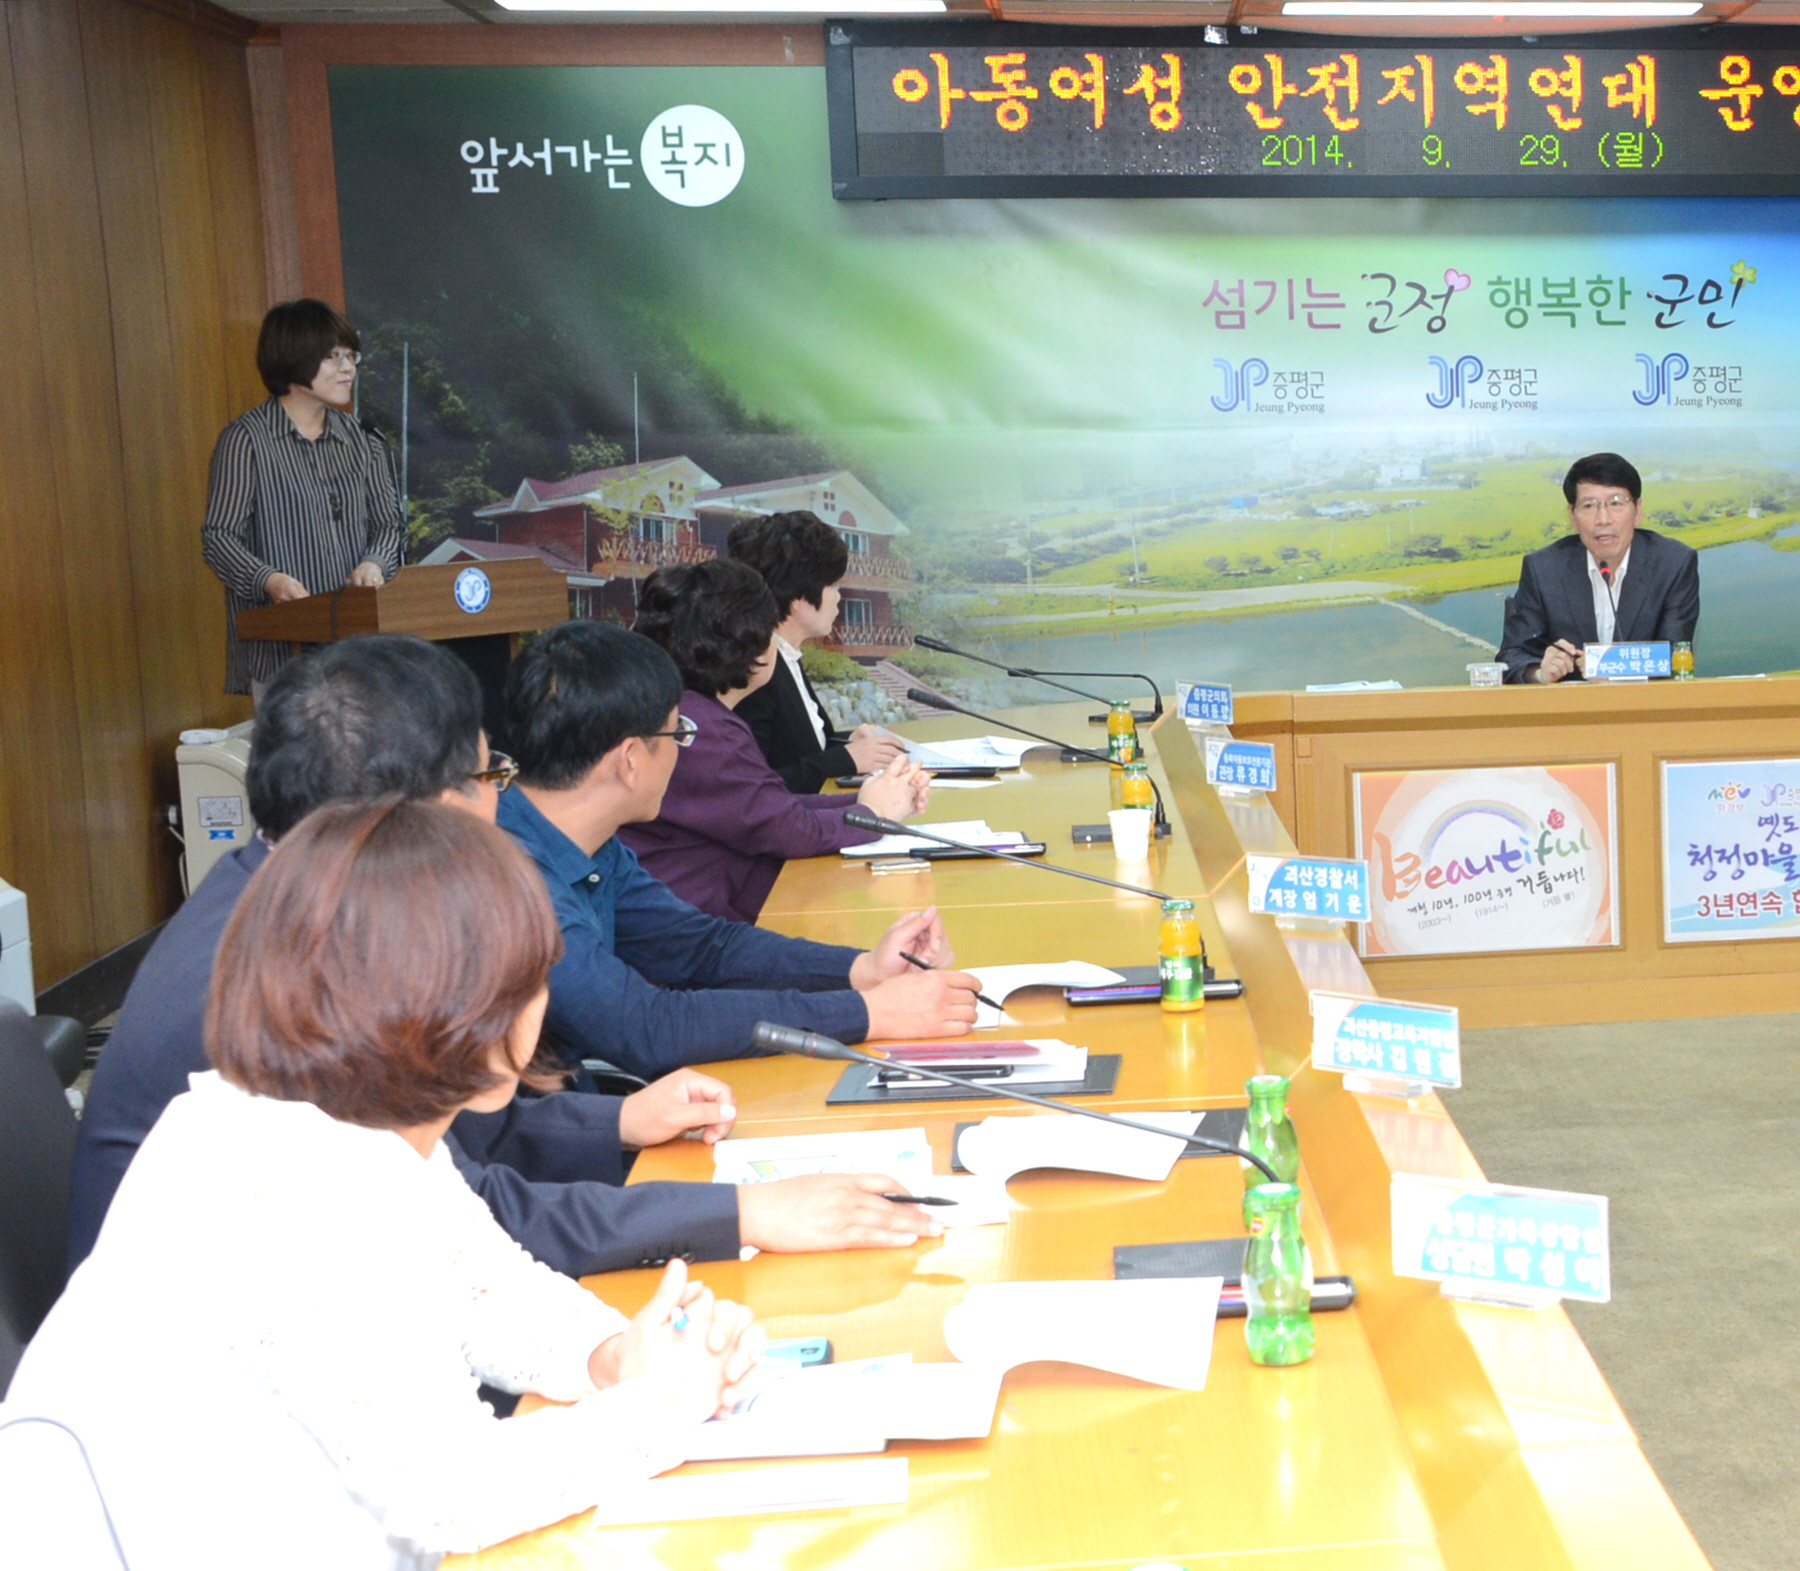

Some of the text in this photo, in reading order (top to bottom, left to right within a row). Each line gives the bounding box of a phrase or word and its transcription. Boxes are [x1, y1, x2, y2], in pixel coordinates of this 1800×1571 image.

[892, 53, 1185, 132] 아동여성
[1227, 53, 1659, 132] 안전지역연대
[460, 125, 731, 193] 앞서가는 복지
[1262, 131, 1664, 172] 2014. 9. 29. (월)
[1202, 270, 1746, 334] 섬기는 군정 행복한 군민
[1273, 371, 1325, 400] 증평군
[1487, 369, 1539, 397] 증평군
[1692, 366, 1743, 394] 증평군
[1254, 402, 1326, 415] Jeung Pyeong
[1468, 399, 1539, 412] Jeung Pyeong
[1674, 396, 1744, 409] Jeung Pyeong
[1619, 647, 1650, 659] 위원장
[1284, 865, 1359, 890] 괴산경찰서
[1373, 827, 1592, 902] Beautiful
[1269, 888, 1297, 909] 계장
[1697, 890, 1783, 918] 3년연속
